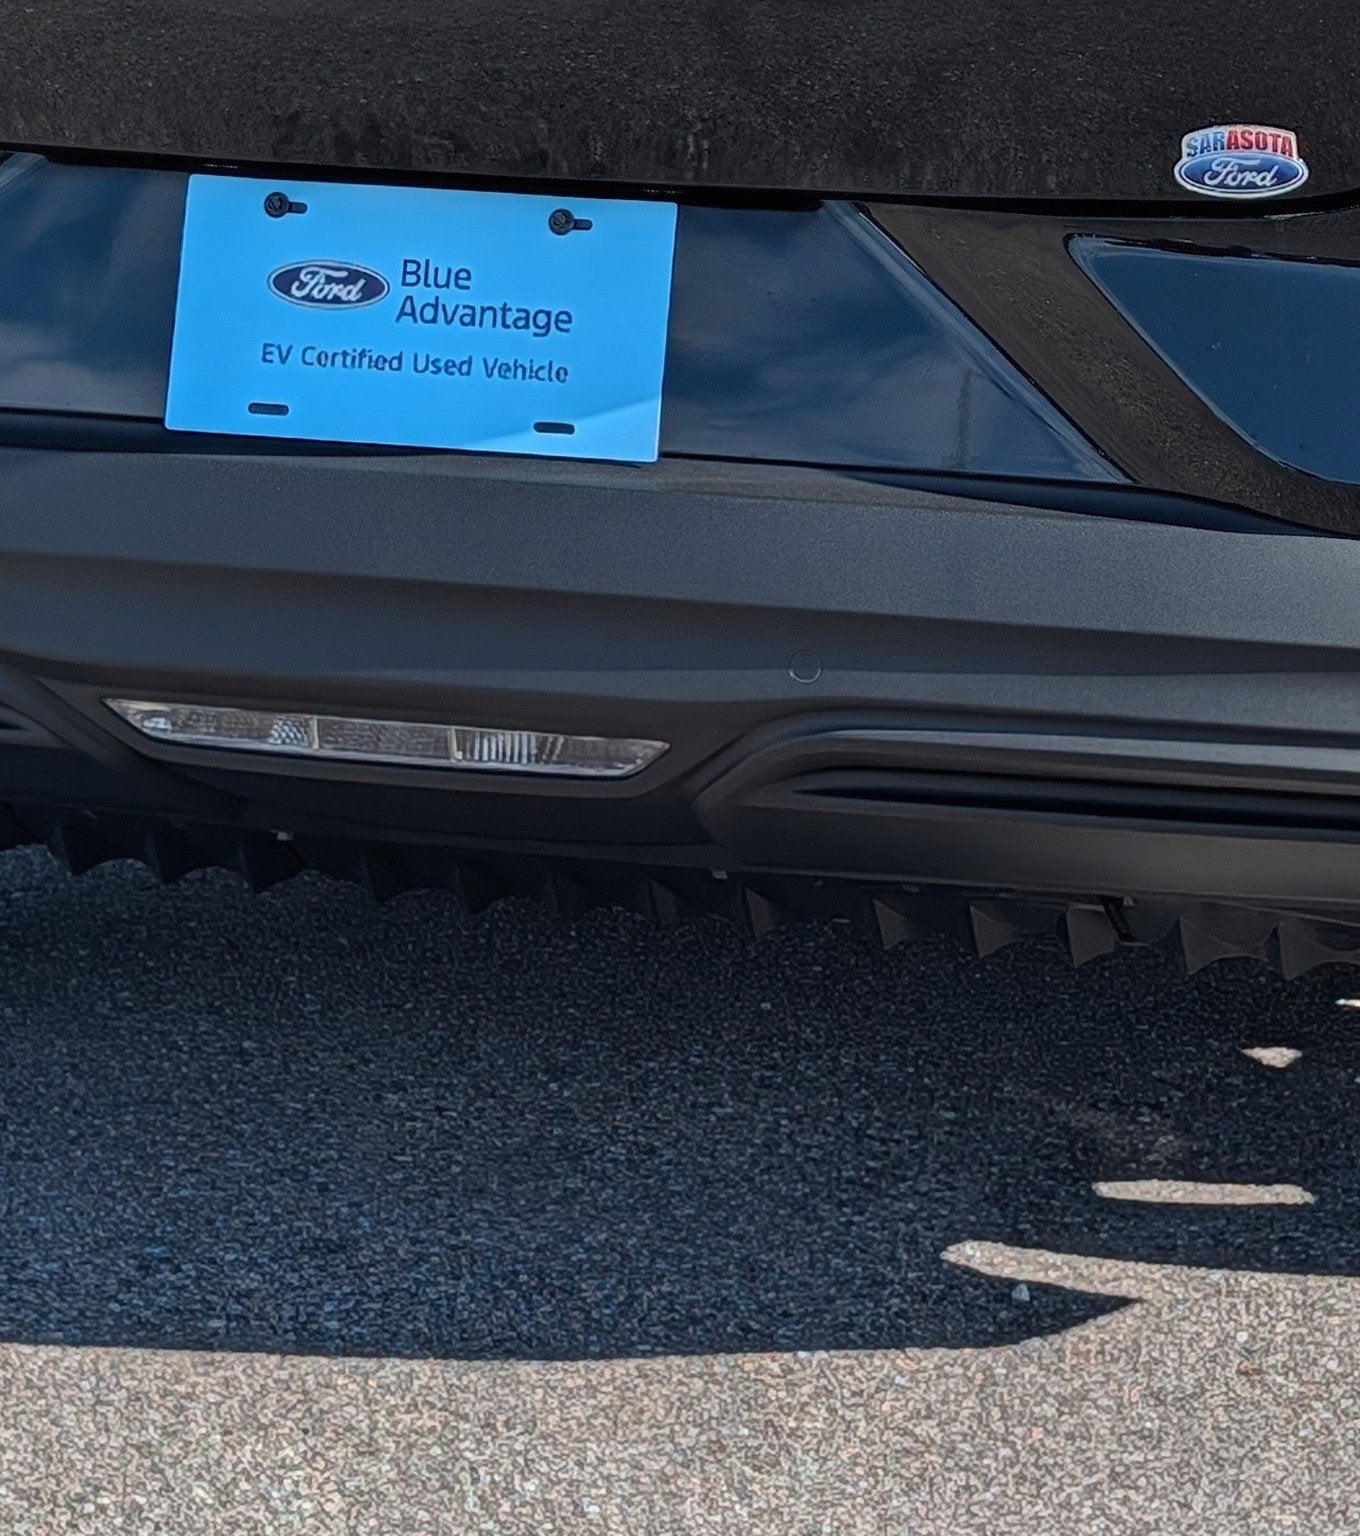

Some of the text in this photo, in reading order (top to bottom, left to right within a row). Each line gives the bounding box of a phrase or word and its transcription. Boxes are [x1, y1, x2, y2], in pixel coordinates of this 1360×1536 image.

[1187, 129, 1293, 157] SARASOTA
[1203, 157, 1279, 187] Ford
[291, 266, 366, 302] Ford
[401, 258, 472, 290] Blue
[394, 295, 573, 338] Advantage
[261, 342, 569, 384] EV Certified Used Vehicle
